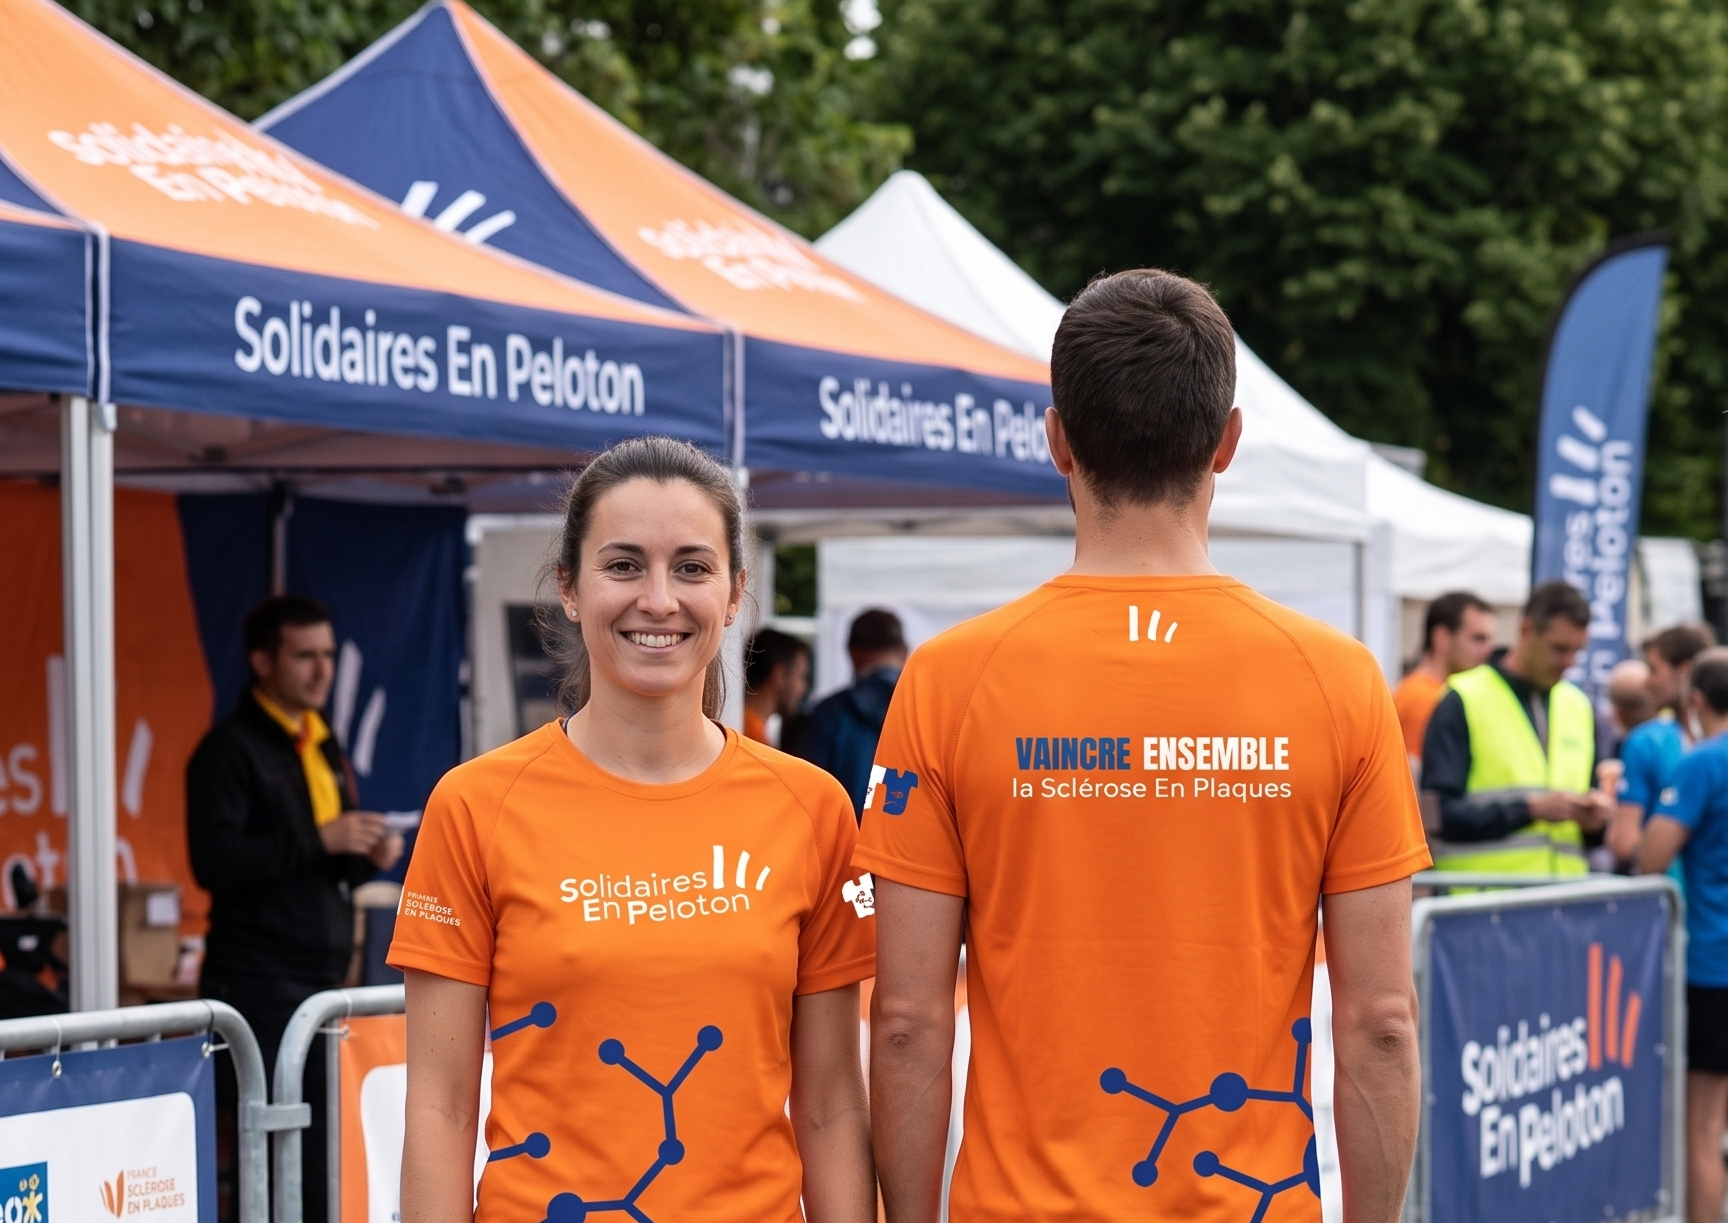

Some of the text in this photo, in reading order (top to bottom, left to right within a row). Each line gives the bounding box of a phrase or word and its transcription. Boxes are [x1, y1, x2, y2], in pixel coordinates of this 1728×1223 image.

[234, 296, 646, 417] Solidaires En Peloton
[819, 375, 955, 451] Solidaires
[954, 392, 992, 457] En
[1015, 736, 1290, 771] VAINCRE ENSEMBLE
[1012, 777, 1292, 803] la Sclérose En Plaques
[560, 872, 708, 903] Solidaires
[583, 893, 750, 925] En Peloton
[1461, 1012, 1588, 1117] Solidaires
[1480, 1075, 1624, 1189] En Peloton
